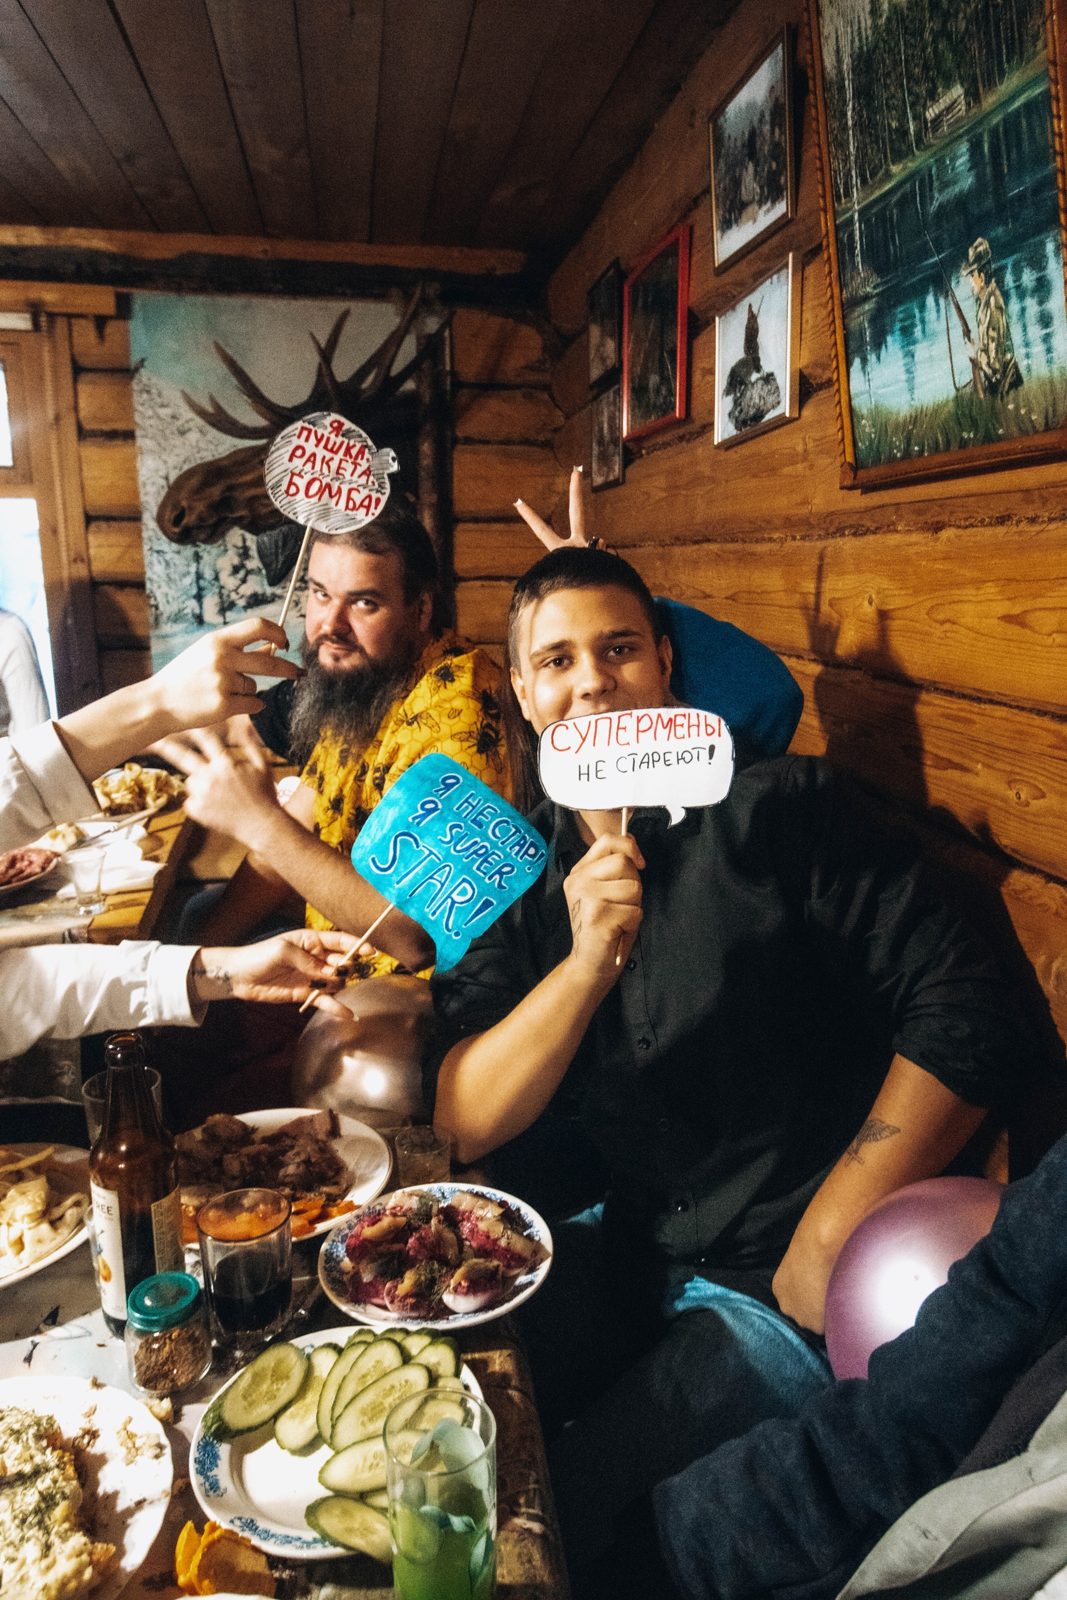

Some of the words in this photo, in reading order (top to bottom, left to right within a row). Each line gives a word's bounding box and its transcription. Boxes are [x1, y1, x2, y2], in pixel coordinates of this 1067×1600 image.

[328, 418, 345, 438] Я
[284, 470, 382, 517] БОМБА!
[550, 711, 723, 754] СУПЕРМЕНЫ
[577, 760, 607, 782] НЕ
[616, 744, 716, 773] СТАРЕЮТ!
[431, 773, 463, 800] Я
[407, 796, 442, 827] Я
[437, 821, 518, 891] SUPER
[368, 829, 497, 940] STAR!
